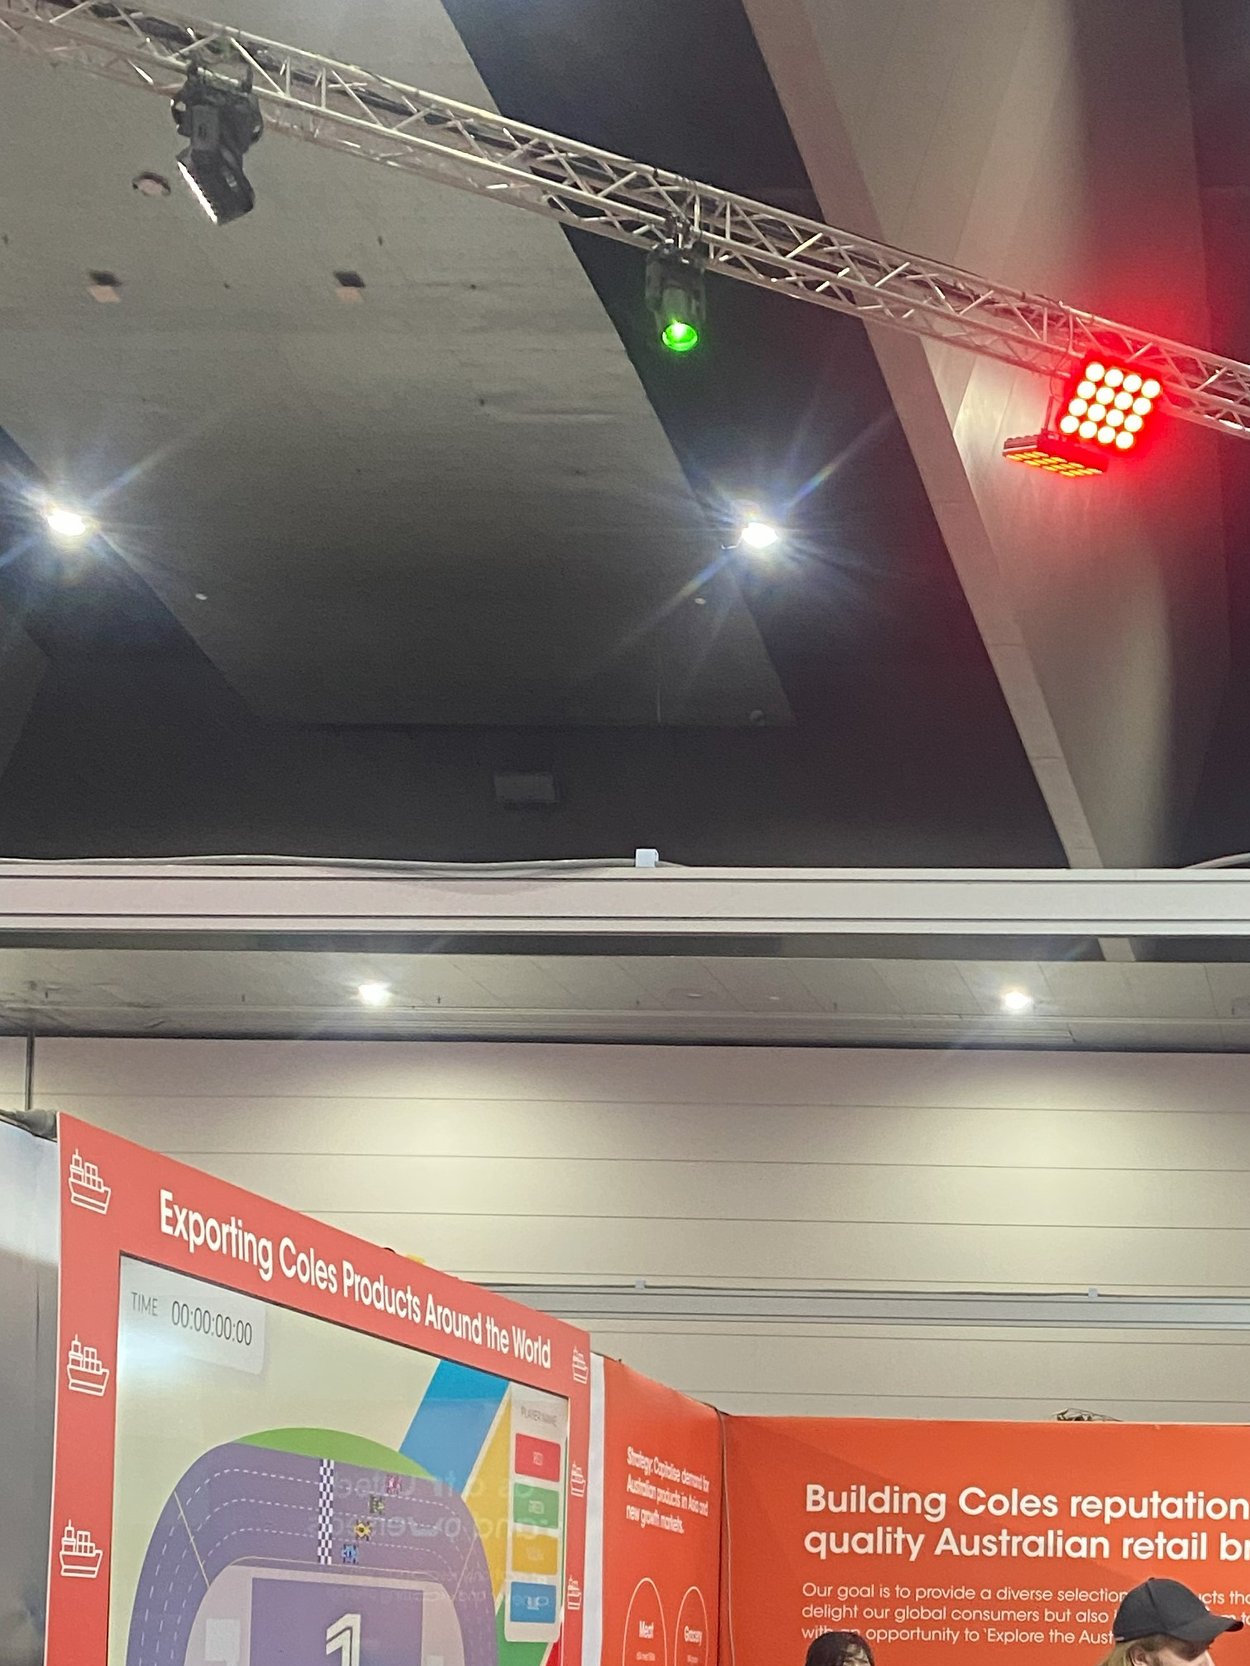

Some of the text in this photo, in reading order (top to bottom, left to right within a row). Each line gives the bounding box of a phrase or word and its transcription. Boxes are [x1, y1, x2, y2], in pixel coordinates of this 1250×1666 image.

[160, 1189, 551, 1368] Exporting Coles Products Around the World
[130, 1291, 252, 1346] TIME 00:00:00:00
[805, 1484, 947, 1523] Building
[958, 1486, 1058, 1517] Coles
[1070, 1490, 1250, 1525] reputation
[804, 1526, 925, 1561] quality
[934, 1527, 1110, 1559] Australian
[1121, 1531, 1208, 1561] retail
[802, 1582, 833, 1597] Our
[837, 1583, 875, 1601] goal
[879, 1584, 890, 1598] is
[895, 1584, 911, 1599] to
[915, 1585, 976, 1601] provide
[980, 1588, 992, 1600] a
[996, 1586, 1052, 1601] diverse
[802, 1604, 1109, 1623] delight our global consumers but also
[865, 1627, 960, 1645] opportunity
[964, 1627, 980, 1642] to
[1049, 1629, 1076, 1643] the
